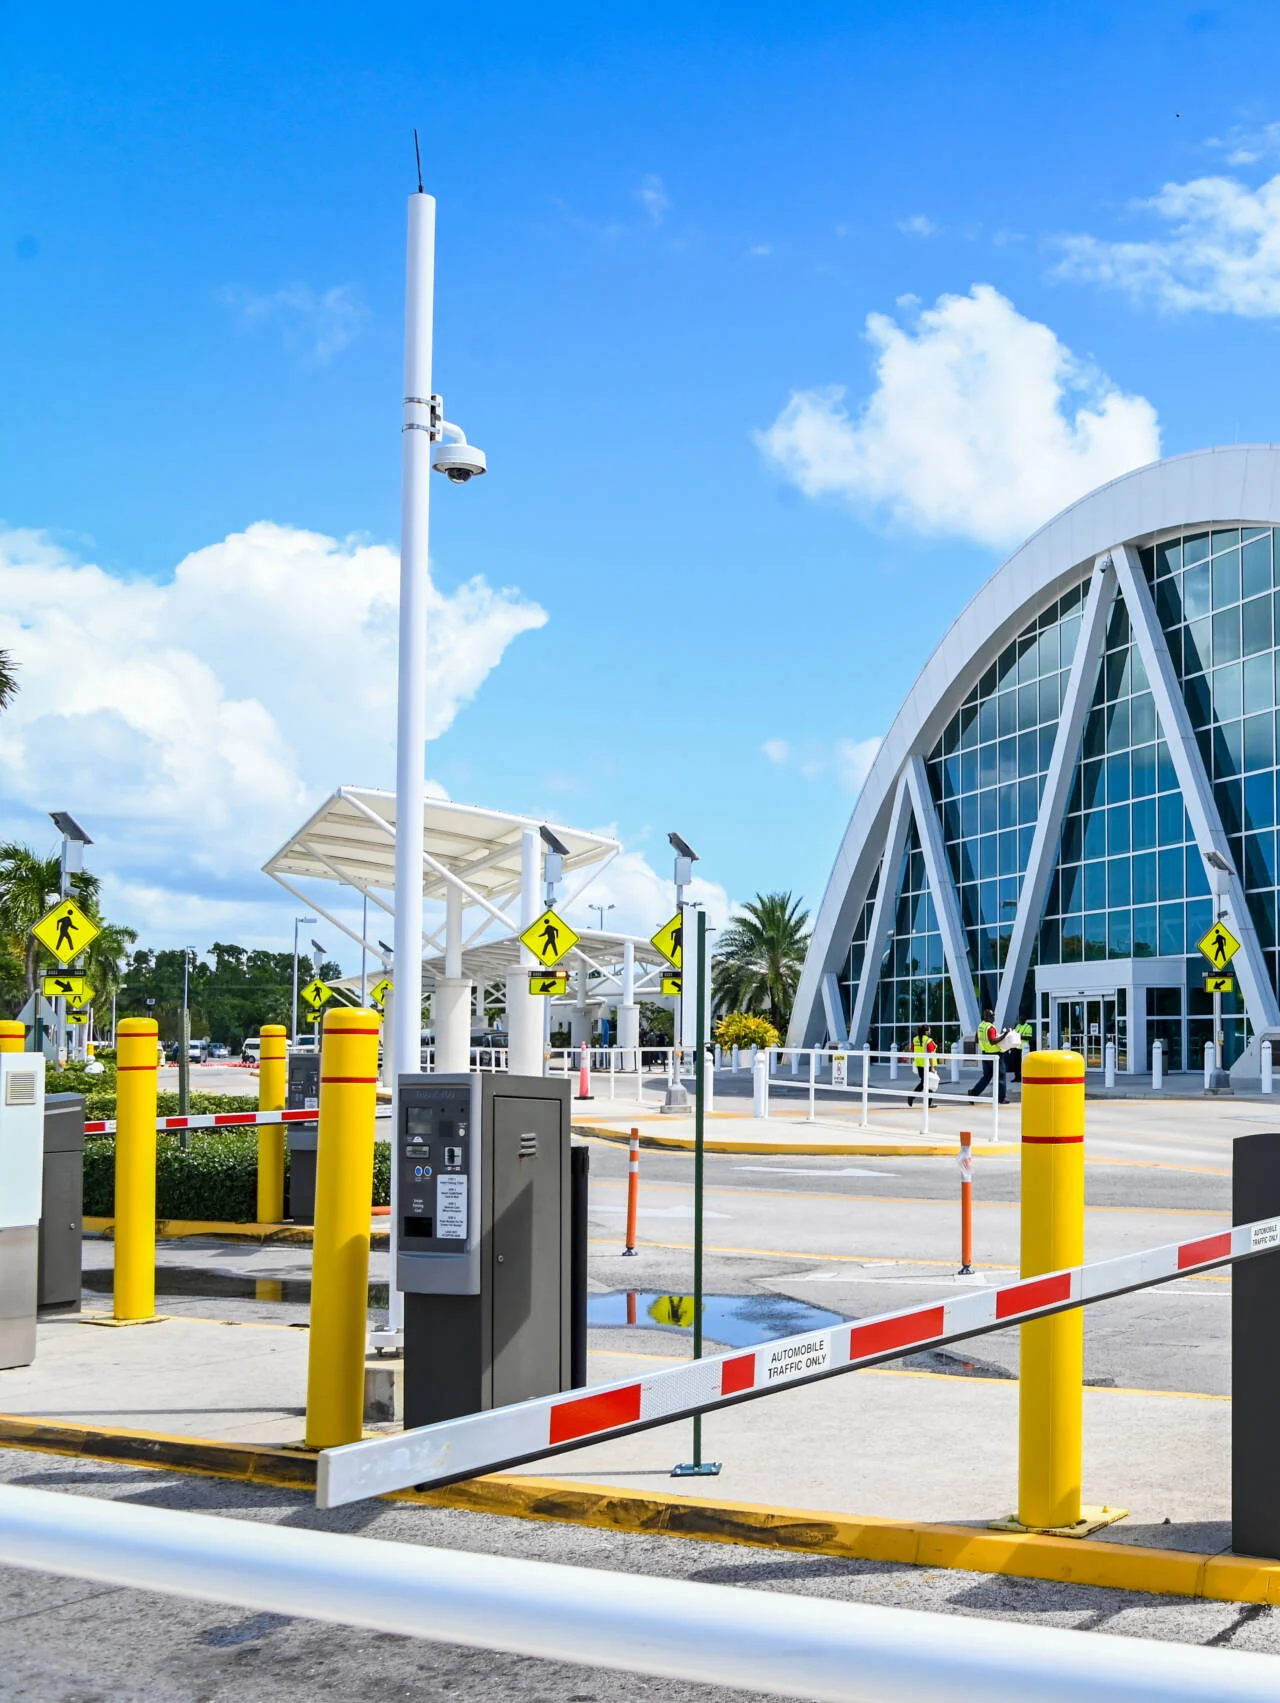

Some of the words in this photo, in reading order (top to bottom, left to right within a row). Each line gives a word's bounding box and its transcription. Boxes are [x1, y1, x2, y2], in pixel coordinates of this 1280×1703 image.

[1254, 1224, 1277, 1236] AUTOMOBILE
[1252, 1237, 1268, 1246] TRAFFIC
[1269, 1234, 1278, 1243] ONLY
[771, 1340, 824, 1363] AUTOMOBILE
[768, 1360, 802, 1379] TRAFFIC
[806, 1354, 826, 1368] ONLY
